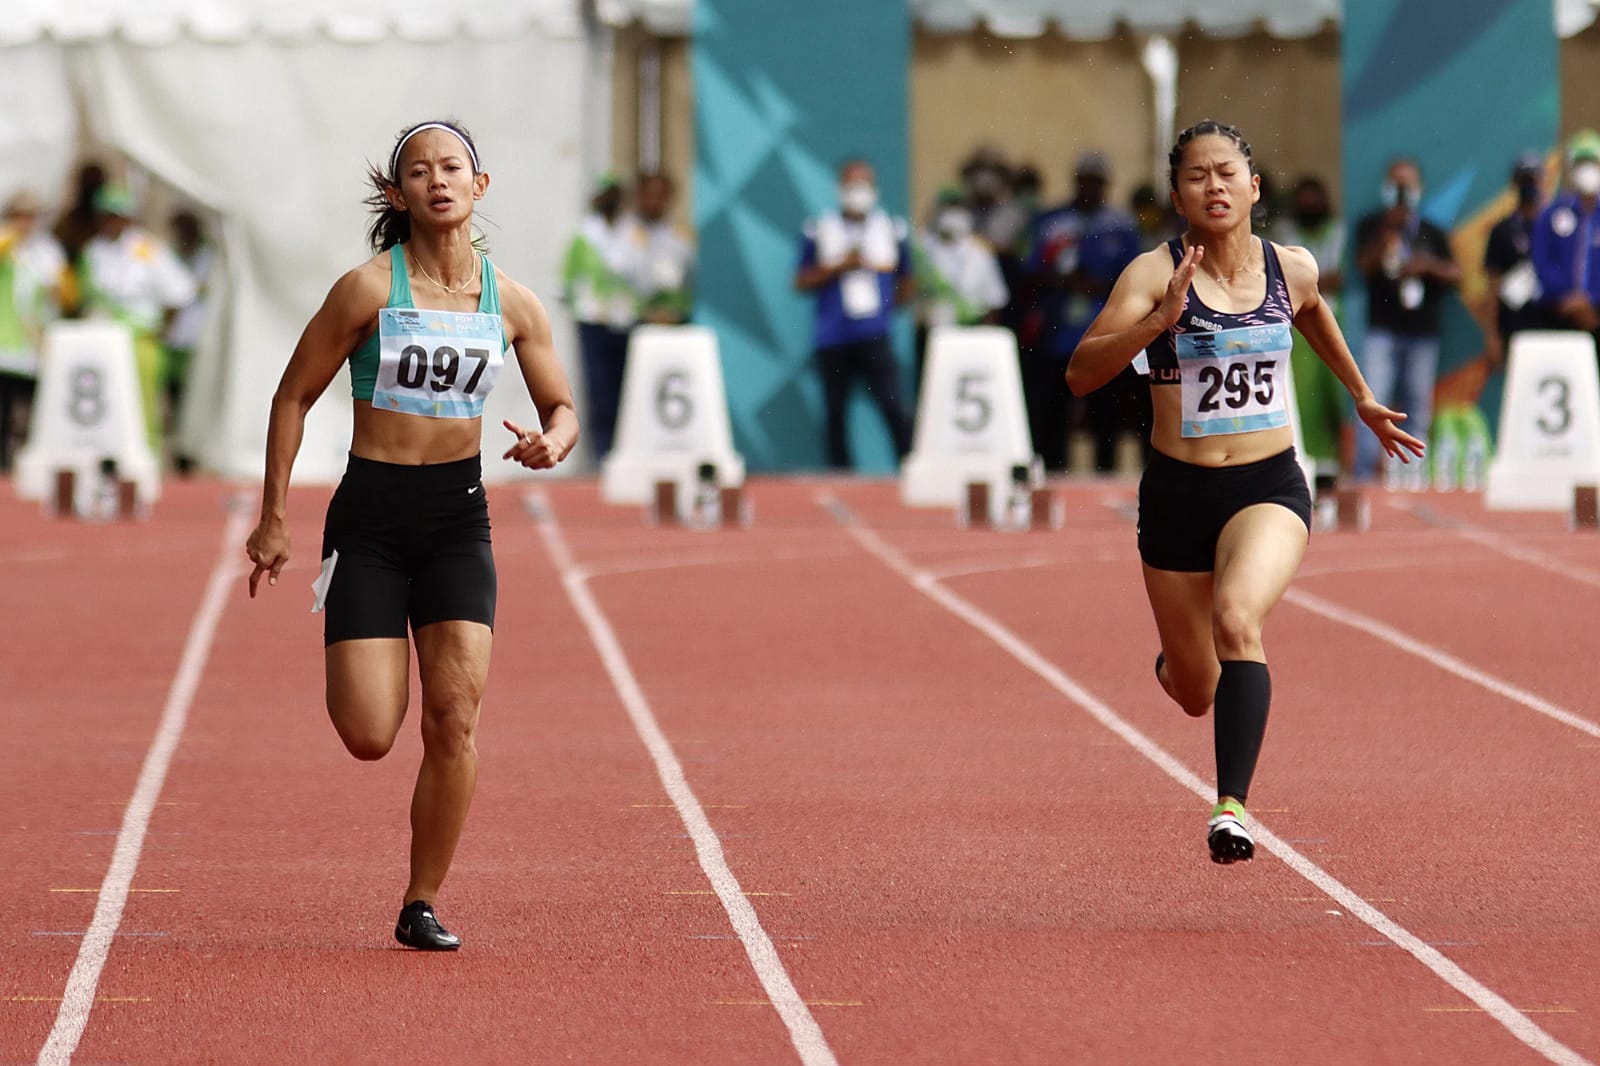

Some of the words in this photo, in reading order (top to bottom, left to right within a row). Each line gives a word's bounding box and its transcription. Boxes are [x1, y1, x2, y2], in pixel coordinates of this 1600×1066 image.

[69, 366, 104, 425] 8
[397, 344, 490, 395] 097
[1197, 360, 1278, 413] 295
[656, 371, 694, 431] 6
[953, 371, 993, 433] 5
[1536, 374, 1571, 436] 3
